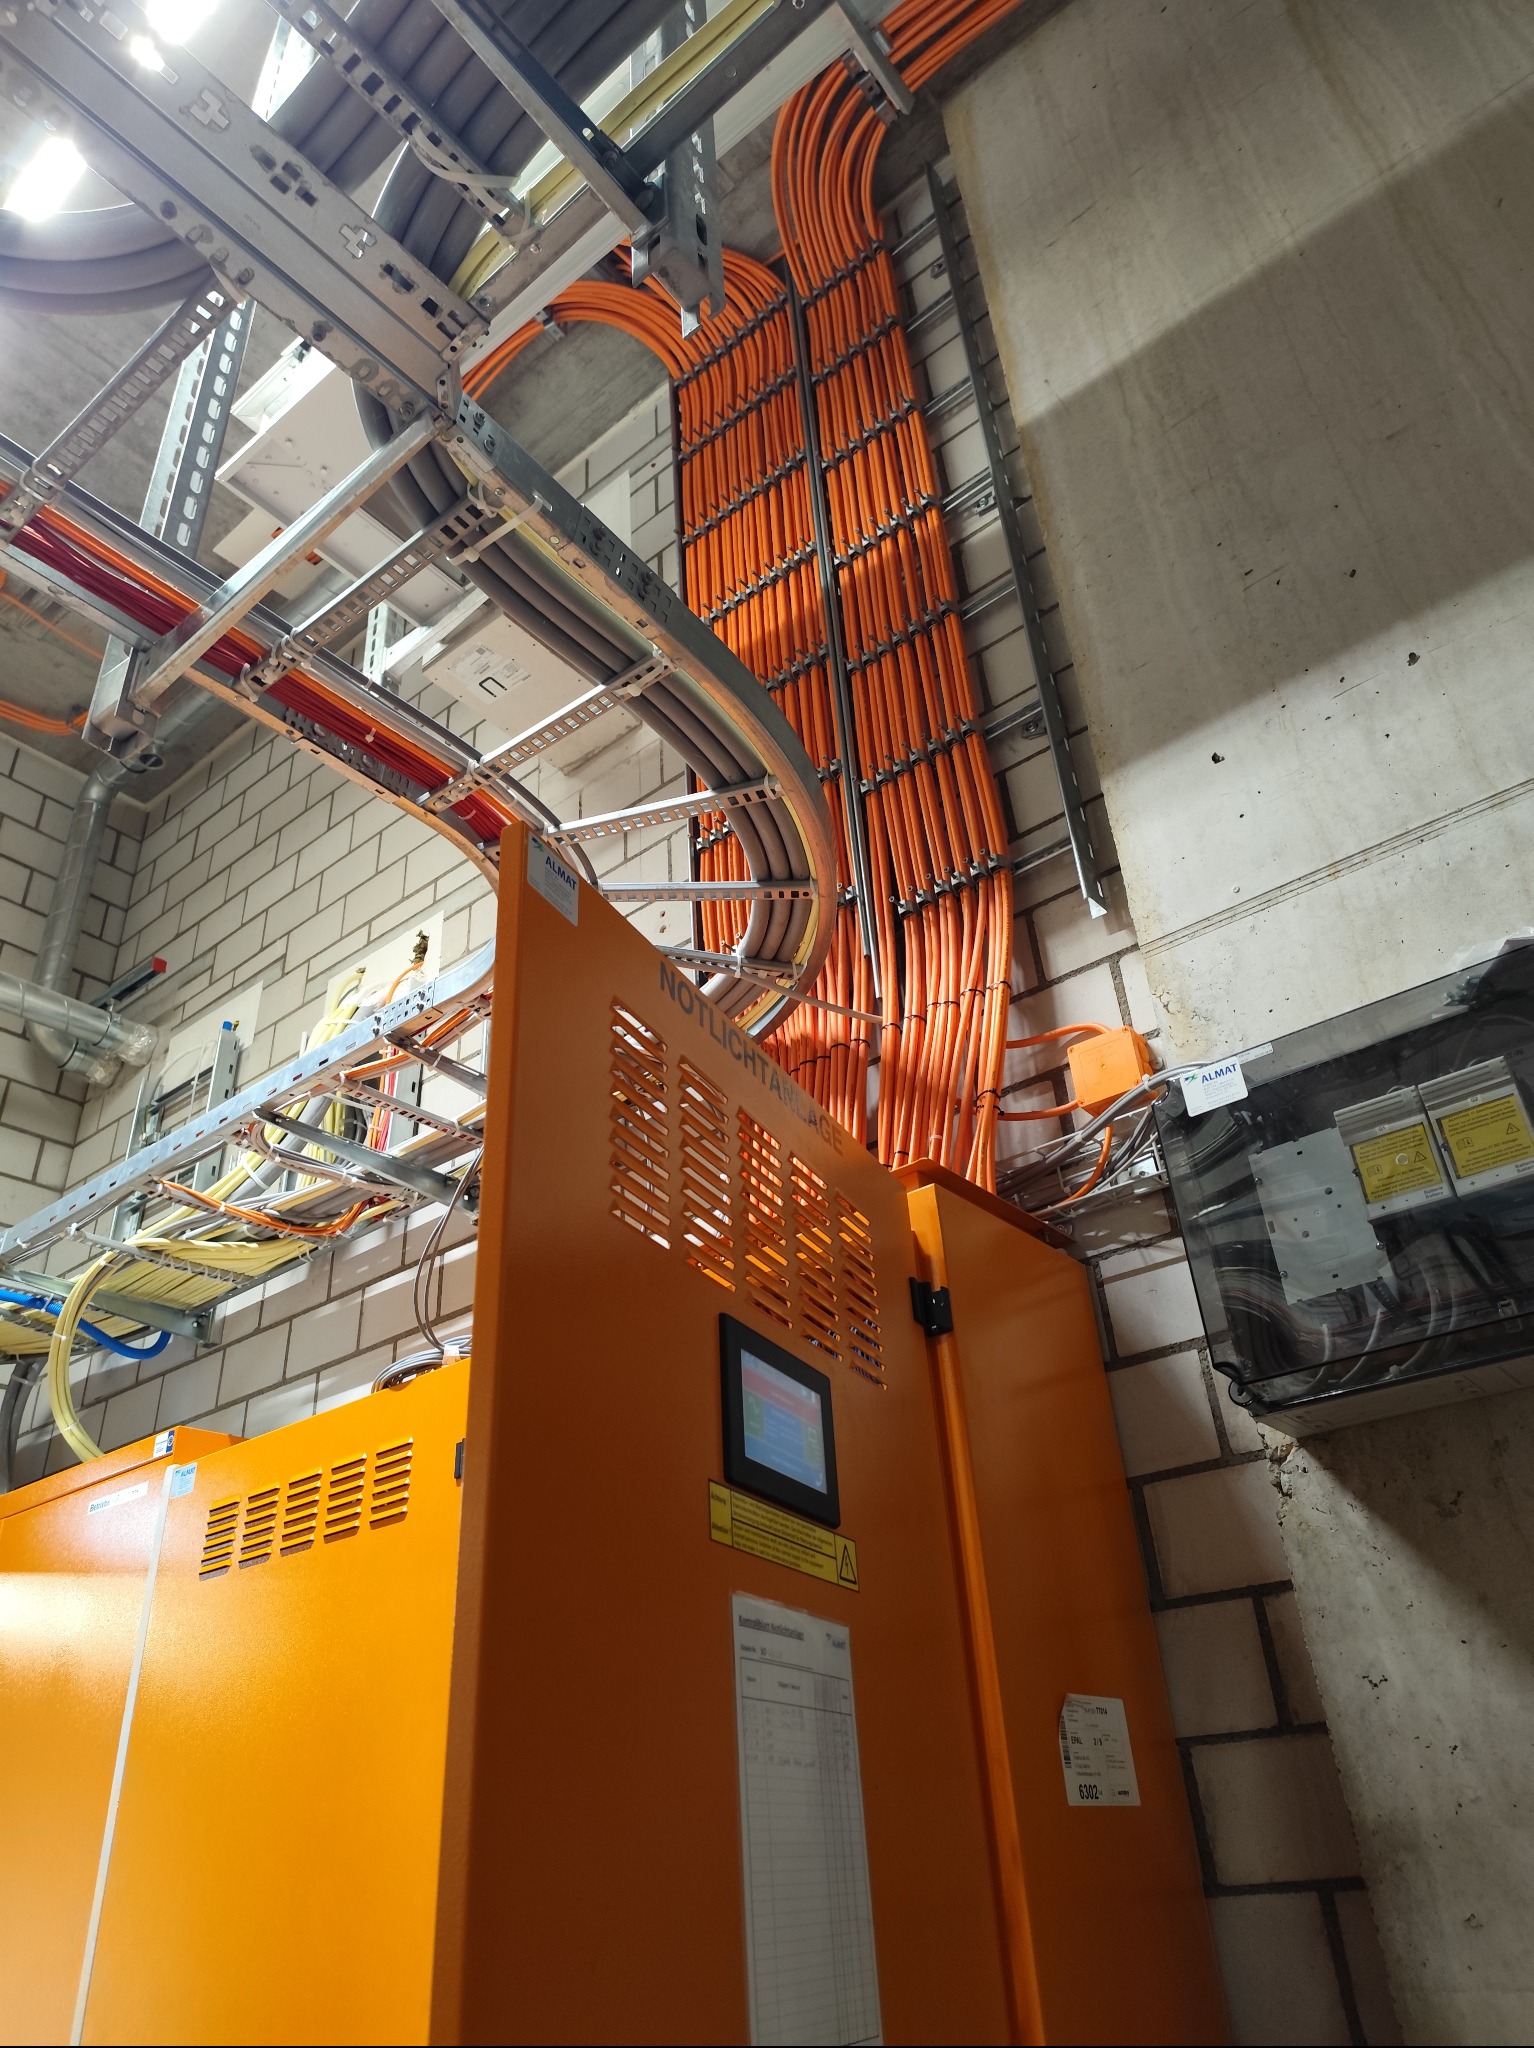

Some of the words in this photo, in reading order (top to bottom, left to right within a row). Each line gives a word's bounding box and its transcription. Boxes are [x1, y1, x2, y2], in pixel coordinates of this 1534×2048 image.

[545, 856, 577, 890] ALMAT
[659, 961, 845, 1158] NOTLICHTANLAGE
[1201, 1063, 1237, 1084] ALMAT
[1071, 1736, 1083, 1745] EPAL
[1078, 1784, 1099, 1800] 6302
